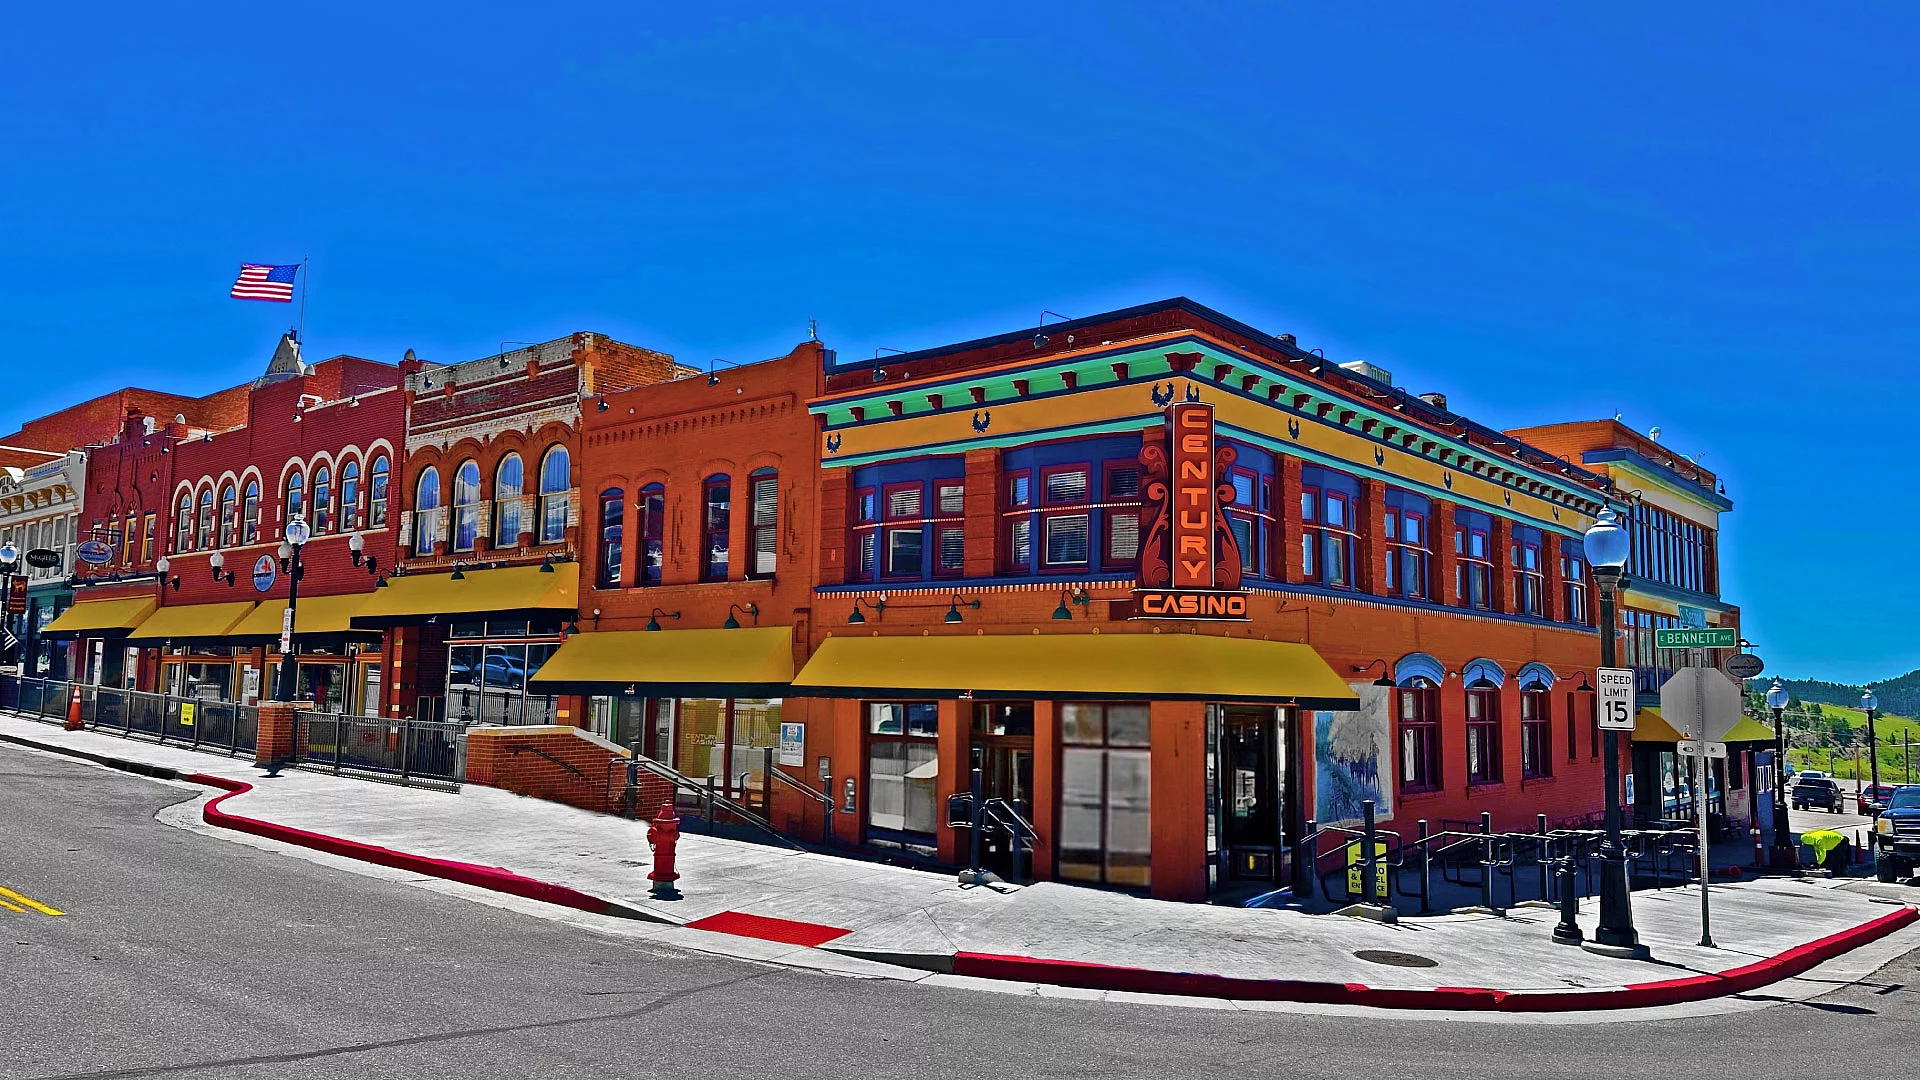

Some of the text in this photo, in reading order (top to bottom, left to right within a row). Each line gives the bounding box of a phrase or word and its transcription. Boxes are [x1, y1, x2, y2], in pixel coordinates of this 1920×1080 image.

[1180, 409, 1208, 579] CENTURY
[1143, 594, 1246, 615] CASINO
[1667, 632, 1718, 644] BENNETT
[1600, 674, 1632, 685] SPEED
[1604, 687, 1628, 697] LIMIT
[1605, 700, 1629, 723] 15
